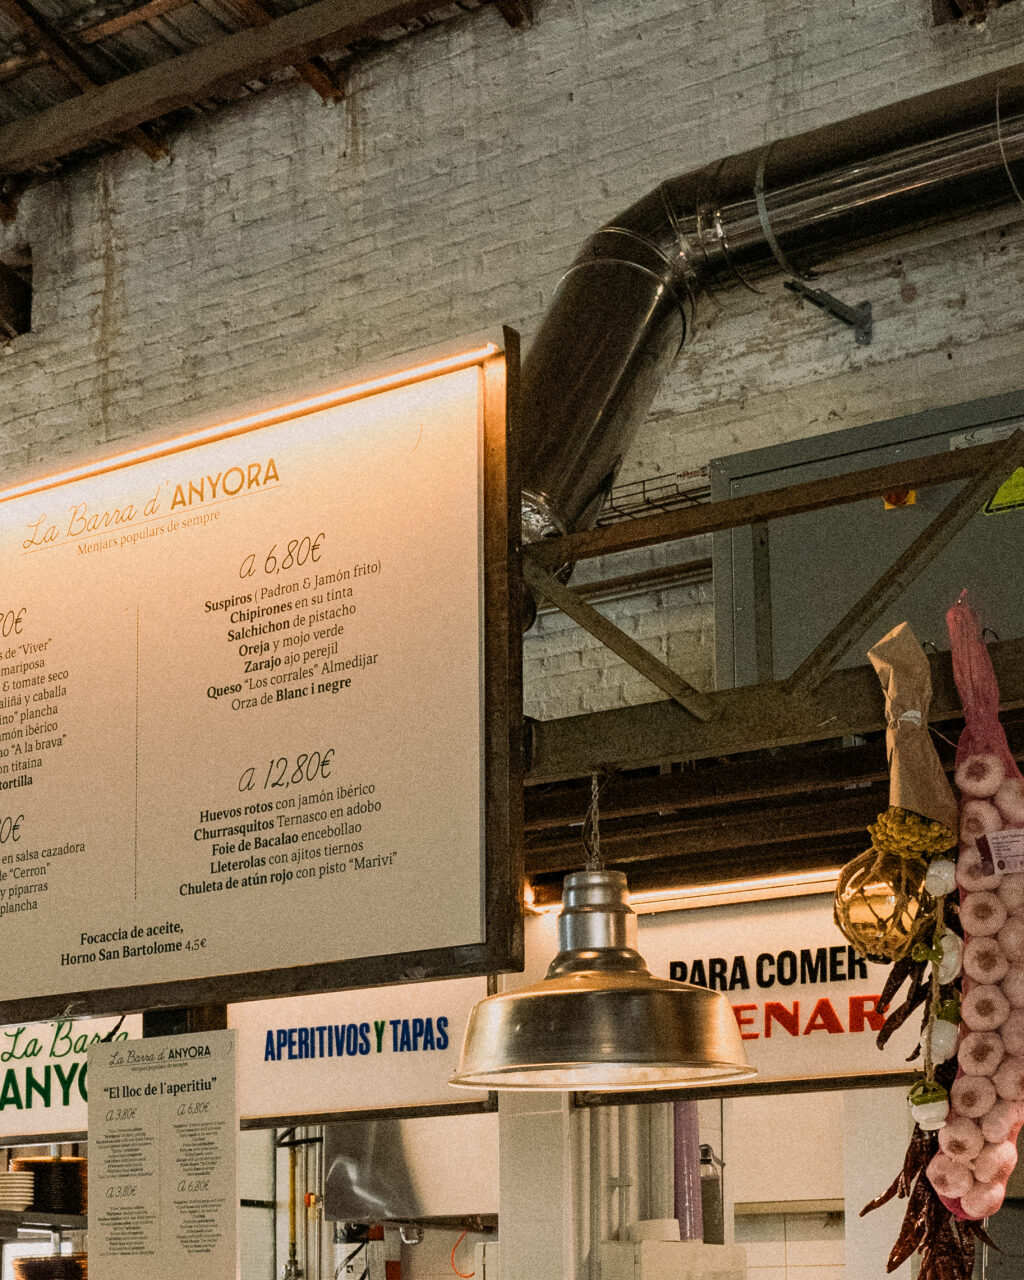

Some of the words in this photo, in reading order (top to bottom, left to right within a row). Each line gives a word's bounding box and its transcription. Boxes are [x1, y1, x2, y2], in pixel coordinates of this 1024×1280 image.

[23, 513, 59, 549] La
[67, 502, 137, 537] Barra
[77, 533, 118, 555] Menjars
[120, 525, 165, 548] populars
[167, 519, 180, 532] de
[182, 511, 220, 530] sempre
[239, 554, 256, 579] a
[264, 532, 325, 574] 6,80€
[205, 594, 252, 613] Suspiros
[261, 583, 299, 600] Padron
[303, 577, 311, 589] &
[314, 569, 350, 590] Jamón
[354, 560, 381, 577] frito)
[230, 602, 292, 624] Chipirones
[295, 598, 308, 609] en
[311, 595, 323, 605] su
[327, 588, 353, 602] tinta
[228, 620, 290, 642] Salchichon
[293, 614, 306, 627] de
[309, 604, 356, 627] pistacho
[5, 648, 16, 659] de
[18, 638, 52, 655] “Viver”
[239, 641, 270, 657] Oreja
[273, 640, 279, 652] y
[283, 632, 310, 647] mojo
[313, 623, 344, 640] verde
[1, 659, 45, 676] mariposa
[244, 656, 281, 674] Zarajo
[284, 653, 300, 667] ajo
[303, 641, 338, 664] perejil
[3, 681, 10, 692] &
[13, 676, 45, 690] tomate
[48, 670, 69, 682] seco
[207, 683, 242, 700] Queso
[244, 678, 268, 690] “Los
[270, 664, 318, 685] corrales”
[321, 654, 378, 675] Almedijar
[0, 696, 22, 709] aliñá
[24, 695, 30, 706] y
[33, 685, 66, 702] caballa
[231, 698, 257, 711] Orza
[260, 692, 273, 705] de
[276, 687, 308, 702] Blanc
[317, 678, 351, 694] negre
[20, 704, 58, 724] plancha
[26, 722, 58, 736] ibérico
[25, 742, 33, 753] la
[35, 734, 67, 750] brava”
[11, 758, 42, 772] titaina
[238, 767, 255, 792] a
[264, 748, 335, 789] 12,80€
[200, 807, 242, 823] Huevos
[244, 802, 273, 815] rotos
[276, 798, 295, 810] con
[298, 789, 334, 810] jamón
[337, 783, 375, 799] ibérico
[194, 819, 274, 841] Churrasquitos
[277, 811, 327, 827] Ternasco
[330, 808, 343, 819] en
[346, 800, 382, 816] adobo
[2, 855, 13, 864] en
[16, 850, 39, 862] salsa
[41, 842, 85, 858] cazadora
[212, 842, 235, 856] Foie
[238, 839, 251, 852] de
[254, 832, 299, 849] Bacalao
[301, 822, 362, 841] encebollao
[9, 862, 50, 879] “Cerron”
[210, 855, 266, 874] Lleterolas
[269, 854, 288, 865] con
[291, 848, 321, 864] ajitos
[324, 842, 363, 856] tiernos
[0, 889, 6, 900] y
[8, 883, 48, 899] piparras
[179, 881, 223, 896] Chuleta
[225, 877, 239, 890] de
[241, 872, 267, 887] atún
[270, 869, 294, 885] rojo
[296, 867, 316, 879] con
[319, 862, 346, 879] pisto
[0, 899, 37, 917] plancha
[80, 928, 128, 946] Focaccia
[130, 925, 144, 938] de
[146, 921, 184, 937] aceite,
[61, 953, 96, 966] Horno
[99, 948, 120, 961] San
[122, 941, 182, 958] Bartolome
[670, 955, 750, 991] PARA
[756, 945, 868, 989] COMER
[732, 995, 891, 1040] ENAR
[1, 1027, 43, 1062] La
[264, 1022, 371, 1061] APERITIVOS
[374, 1020, 386, 1053] Y
[389, 1016, 449, 1052] TAPAS
[104, 1086, 120, 1099] “El
[122, 1085, 142, 1098] lloc
[144, 1083, 158, 1096] de
